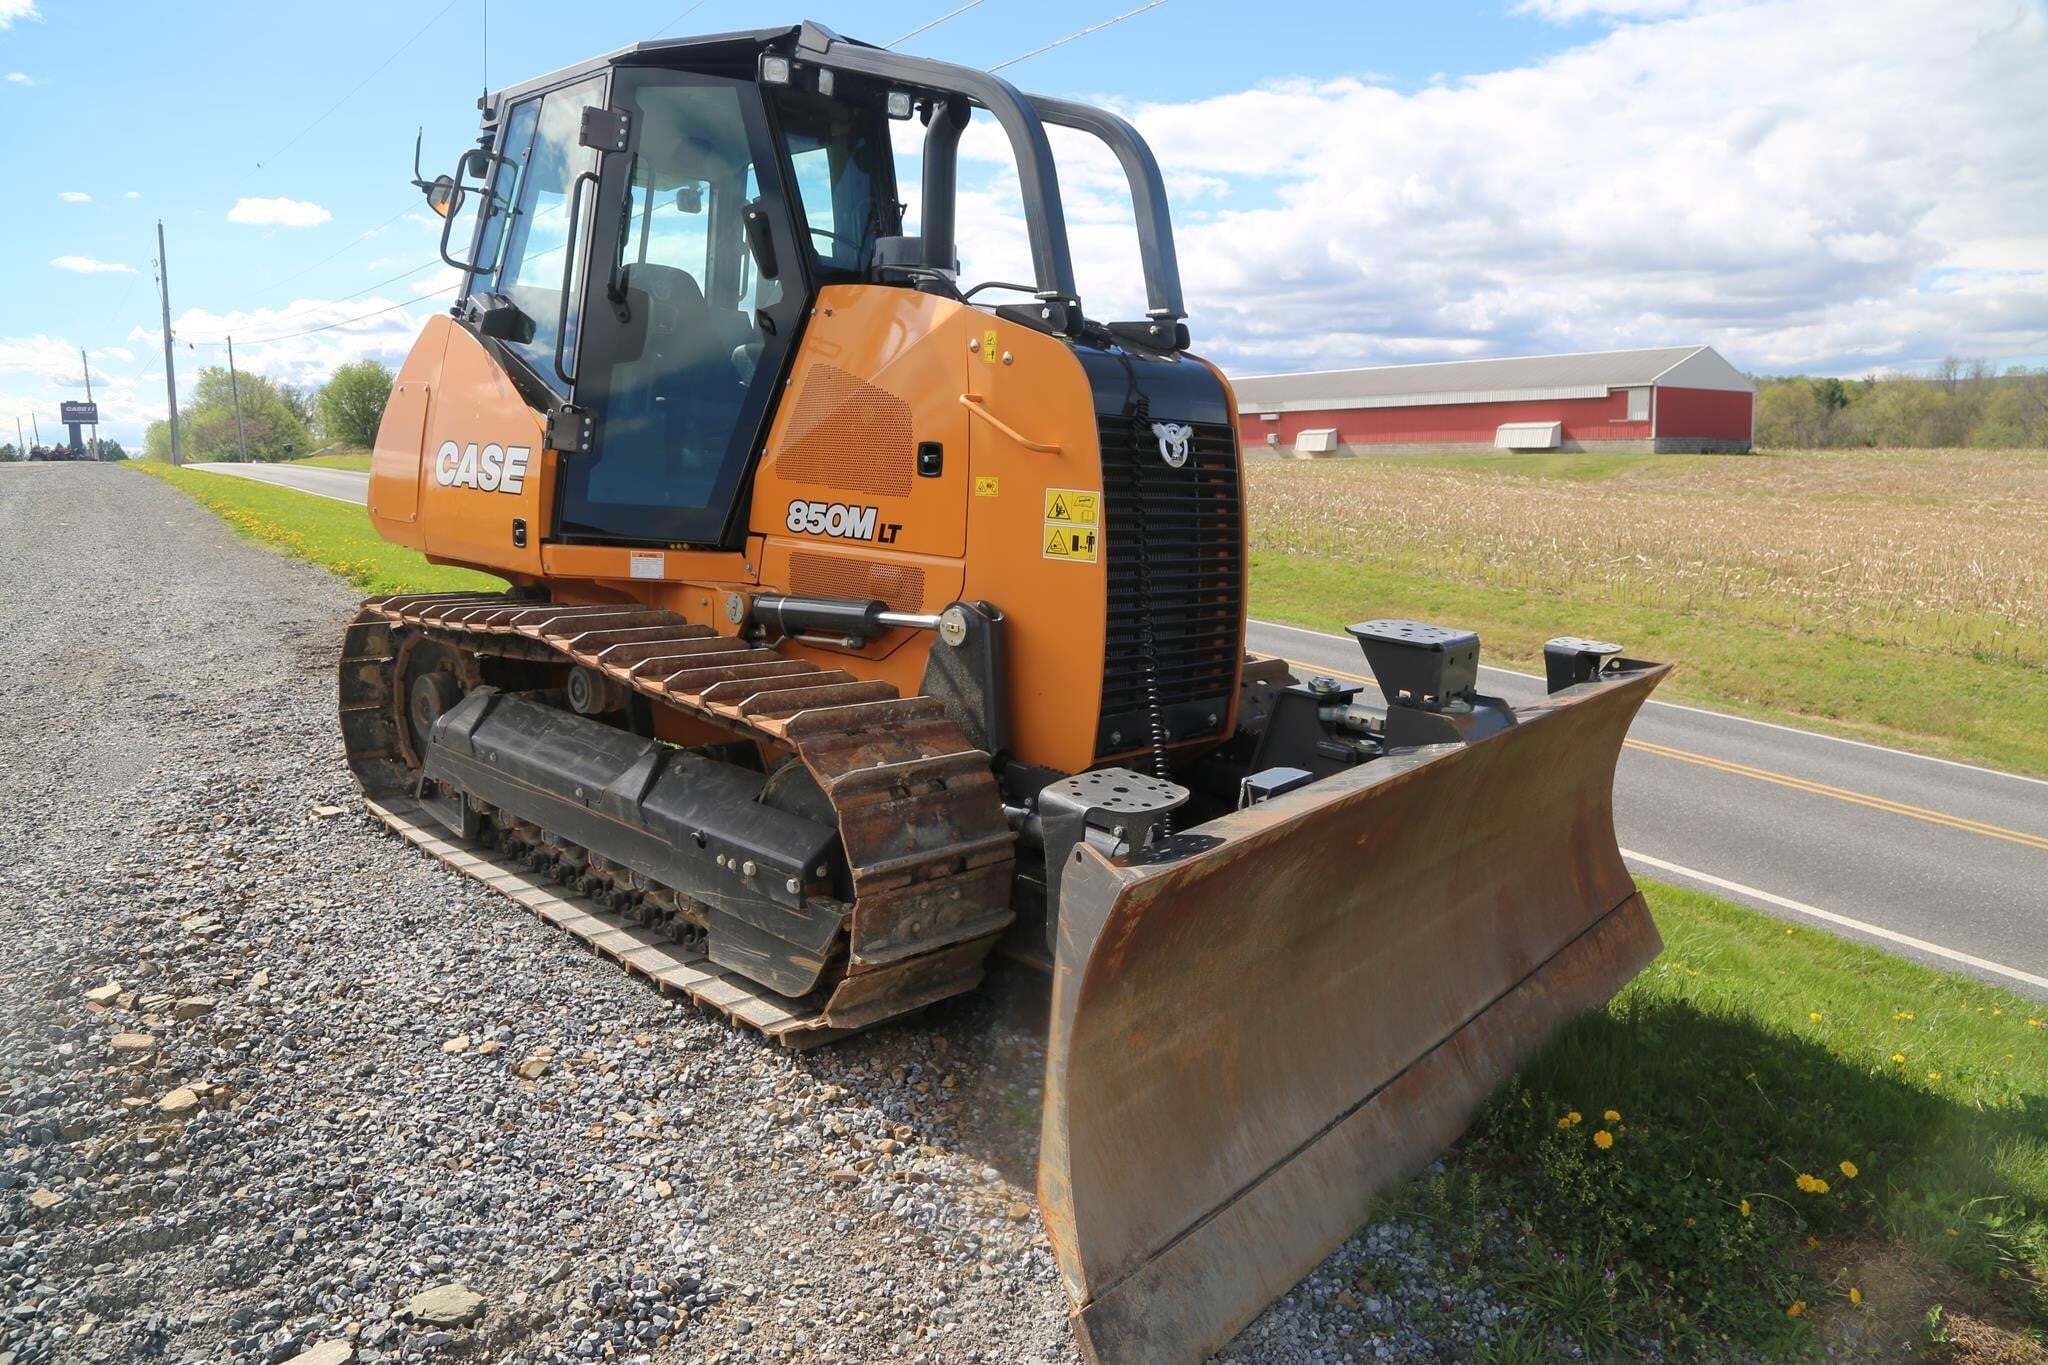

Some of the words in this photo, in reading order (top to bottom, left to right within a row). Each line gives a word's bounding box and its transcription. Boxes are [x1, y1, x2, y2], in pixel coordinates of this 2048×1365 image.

[435, 440, 531, 495] CASE
[786, 499, 879, 541] 850M
[878, 523, 902, 543] LT
